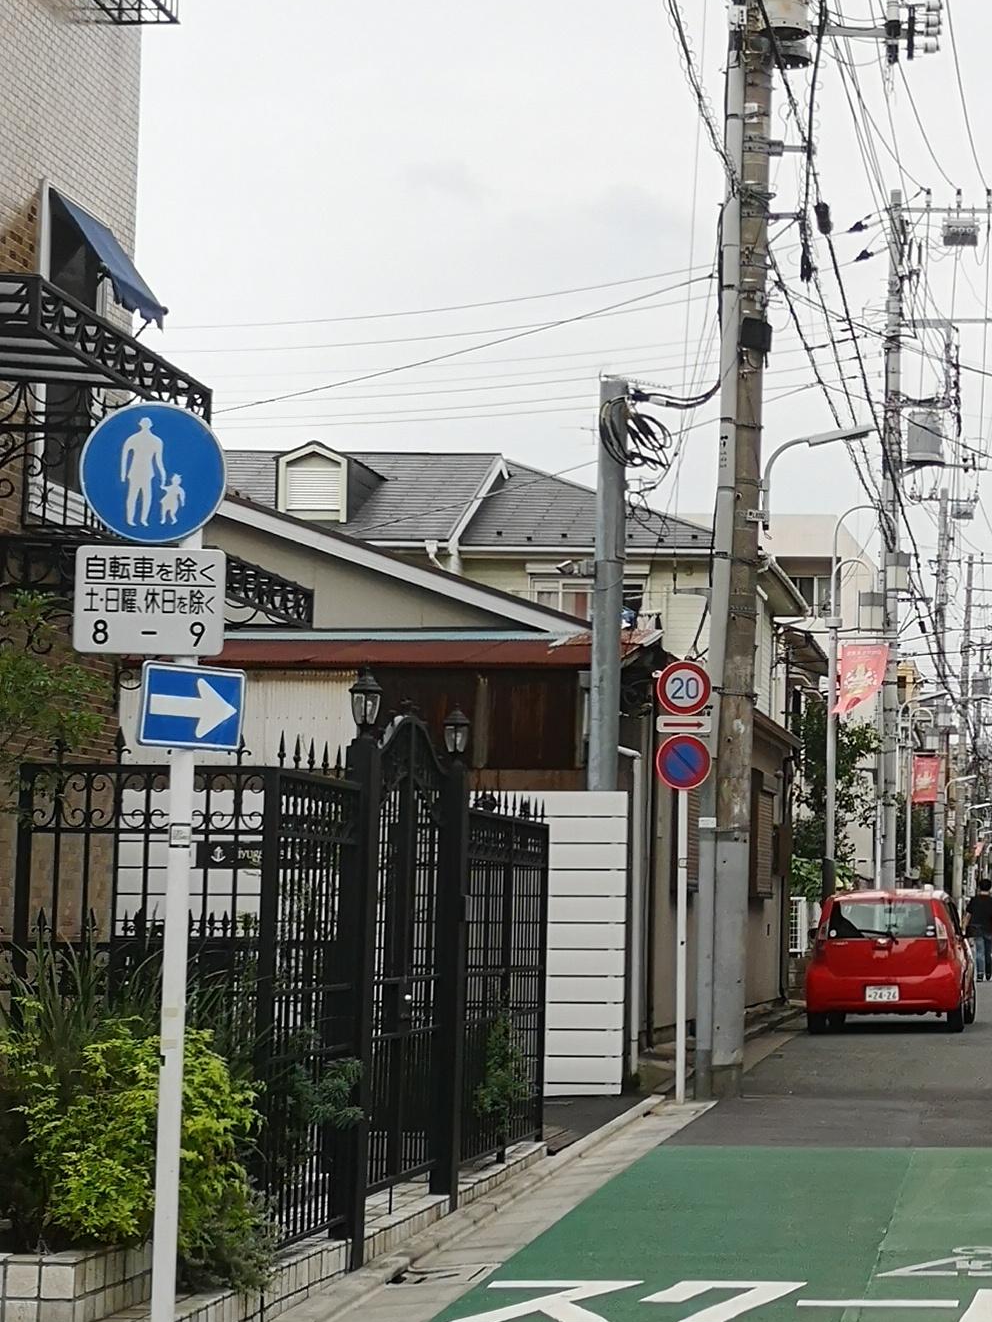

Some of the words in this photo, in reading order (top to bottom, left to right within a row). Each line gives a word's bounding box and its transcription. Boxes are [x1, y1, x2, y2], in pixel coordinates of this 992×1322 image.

[85, 554, 216, 583] 自転車を除く
[92, 619, 109, 645] 8
[189, 621, 206, 647] 9
[670, 676, 699, 700] 20
